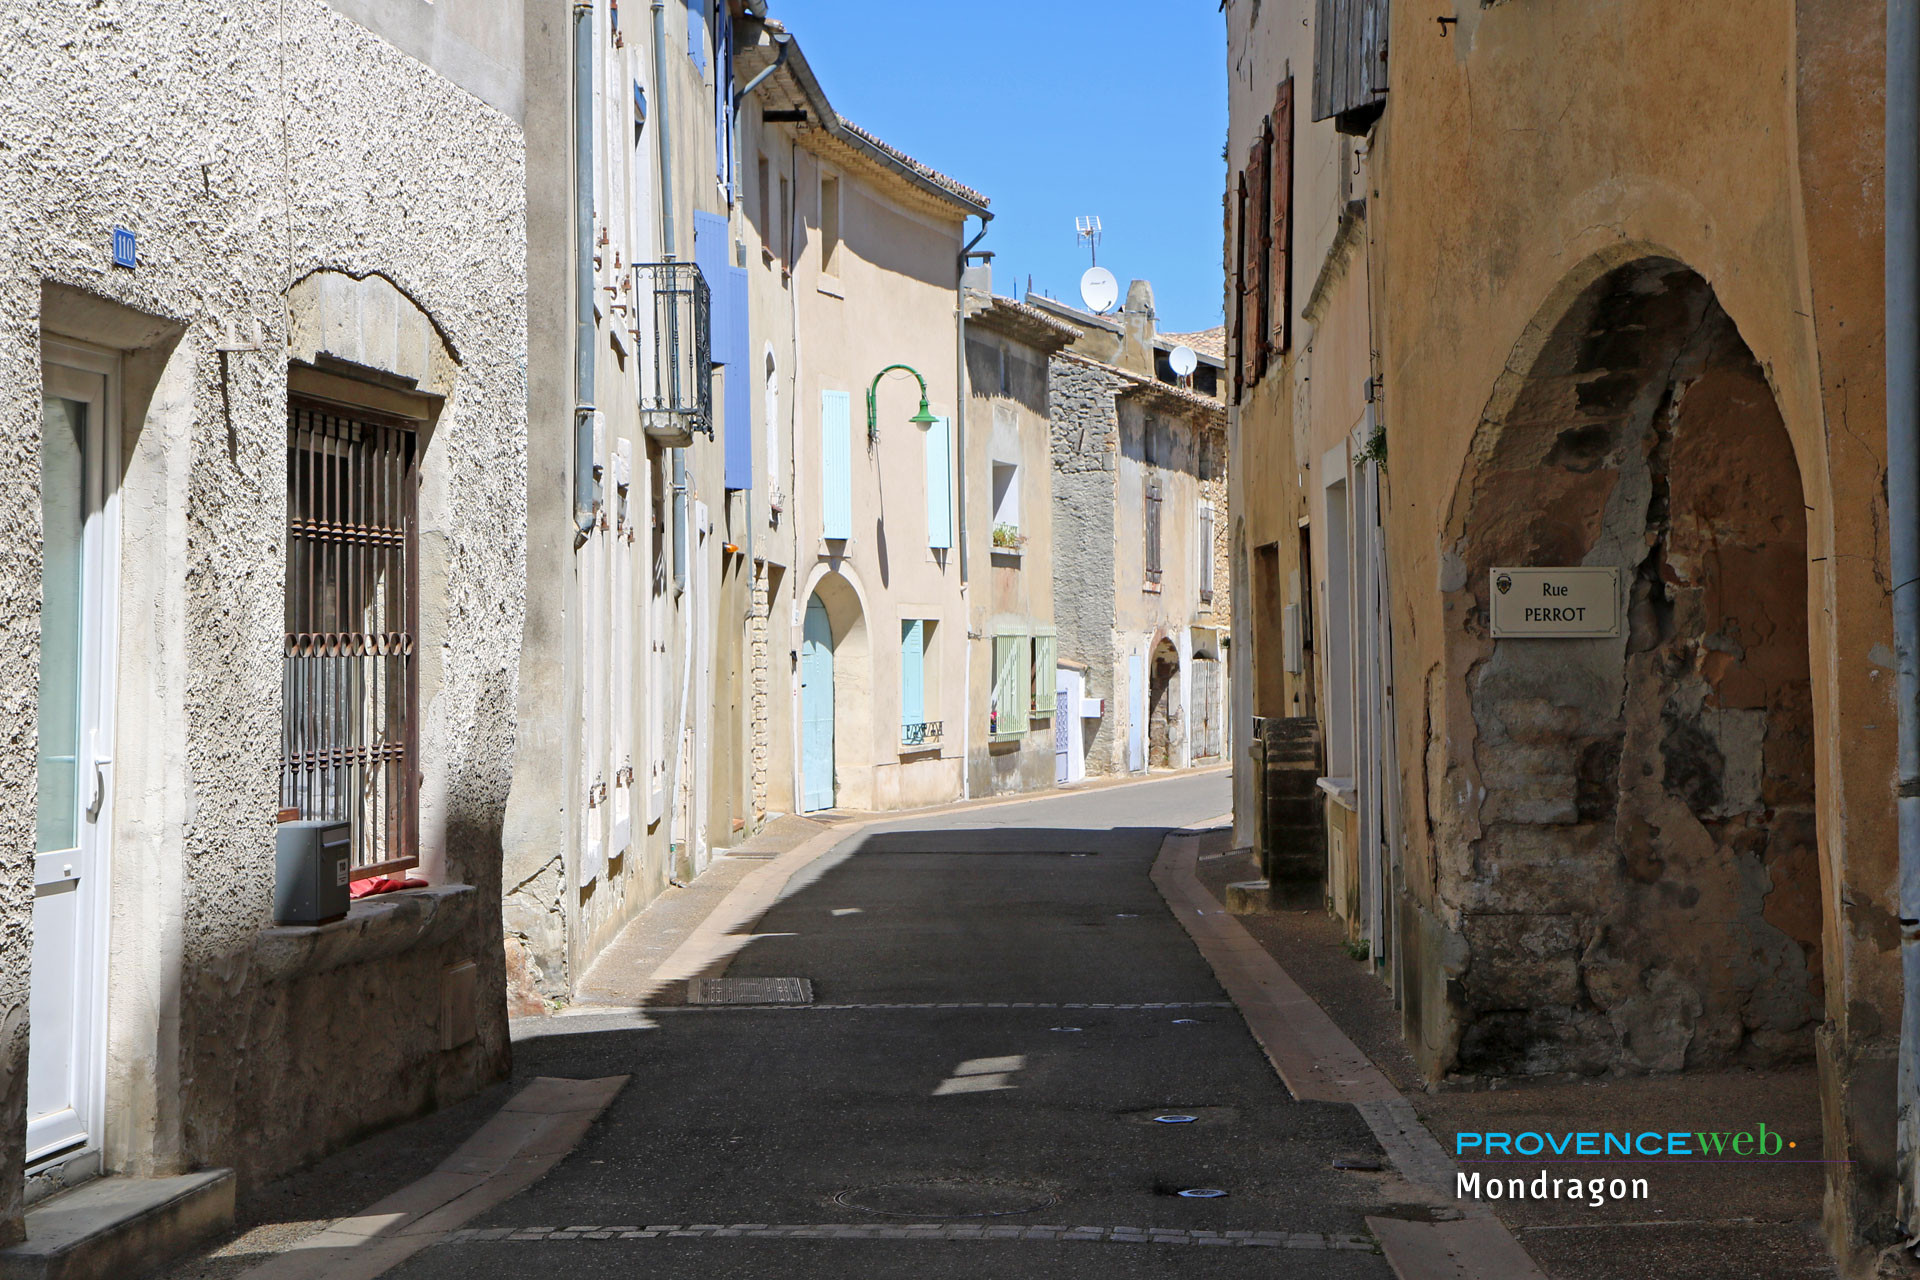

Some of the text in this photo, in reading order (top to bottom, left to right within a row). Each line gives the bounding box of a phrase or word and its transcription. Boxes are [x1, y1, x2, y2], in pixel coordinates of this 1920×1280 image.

[118, 234, 133, 262] 110
[1543, 582, 1568, 597] Rue
[1525, 607, 1586, 622] PERROT
